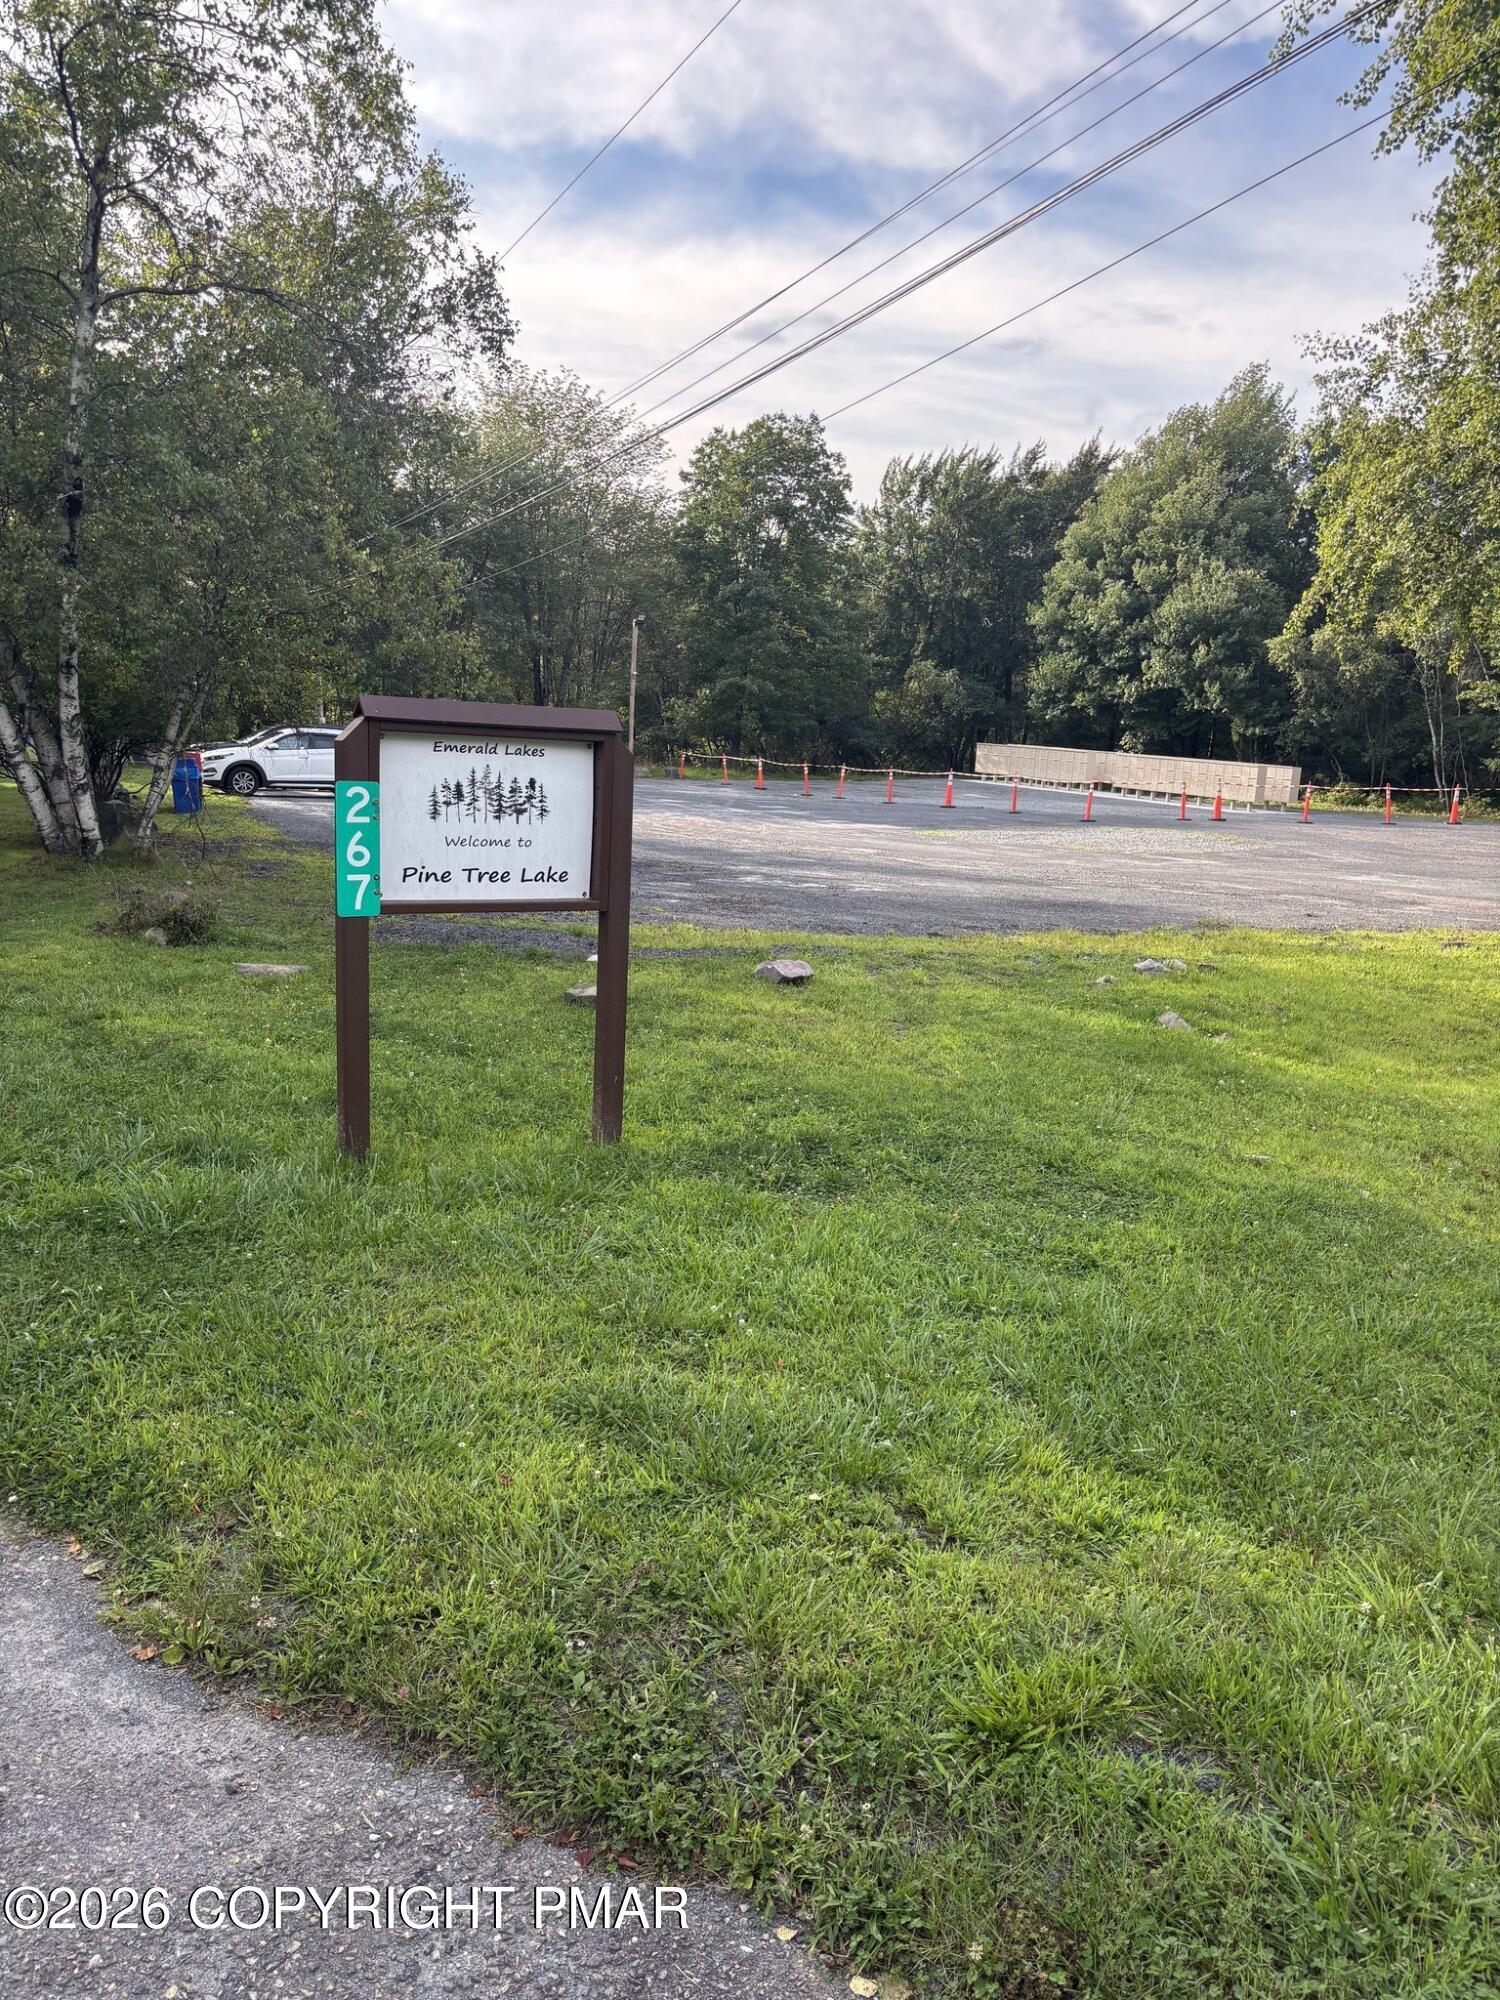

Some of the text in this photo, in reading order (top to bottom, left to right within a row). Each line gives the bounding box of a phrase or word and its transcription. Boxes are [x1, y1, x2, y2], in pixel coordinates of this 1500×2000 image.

[433, 741, 545, 758] Emerald Lakes
[346, 786, 371, 910] 267
[444, 835, 532, 848] Welcome to
[402, 866, 569, 883] Pine Tree Lake
